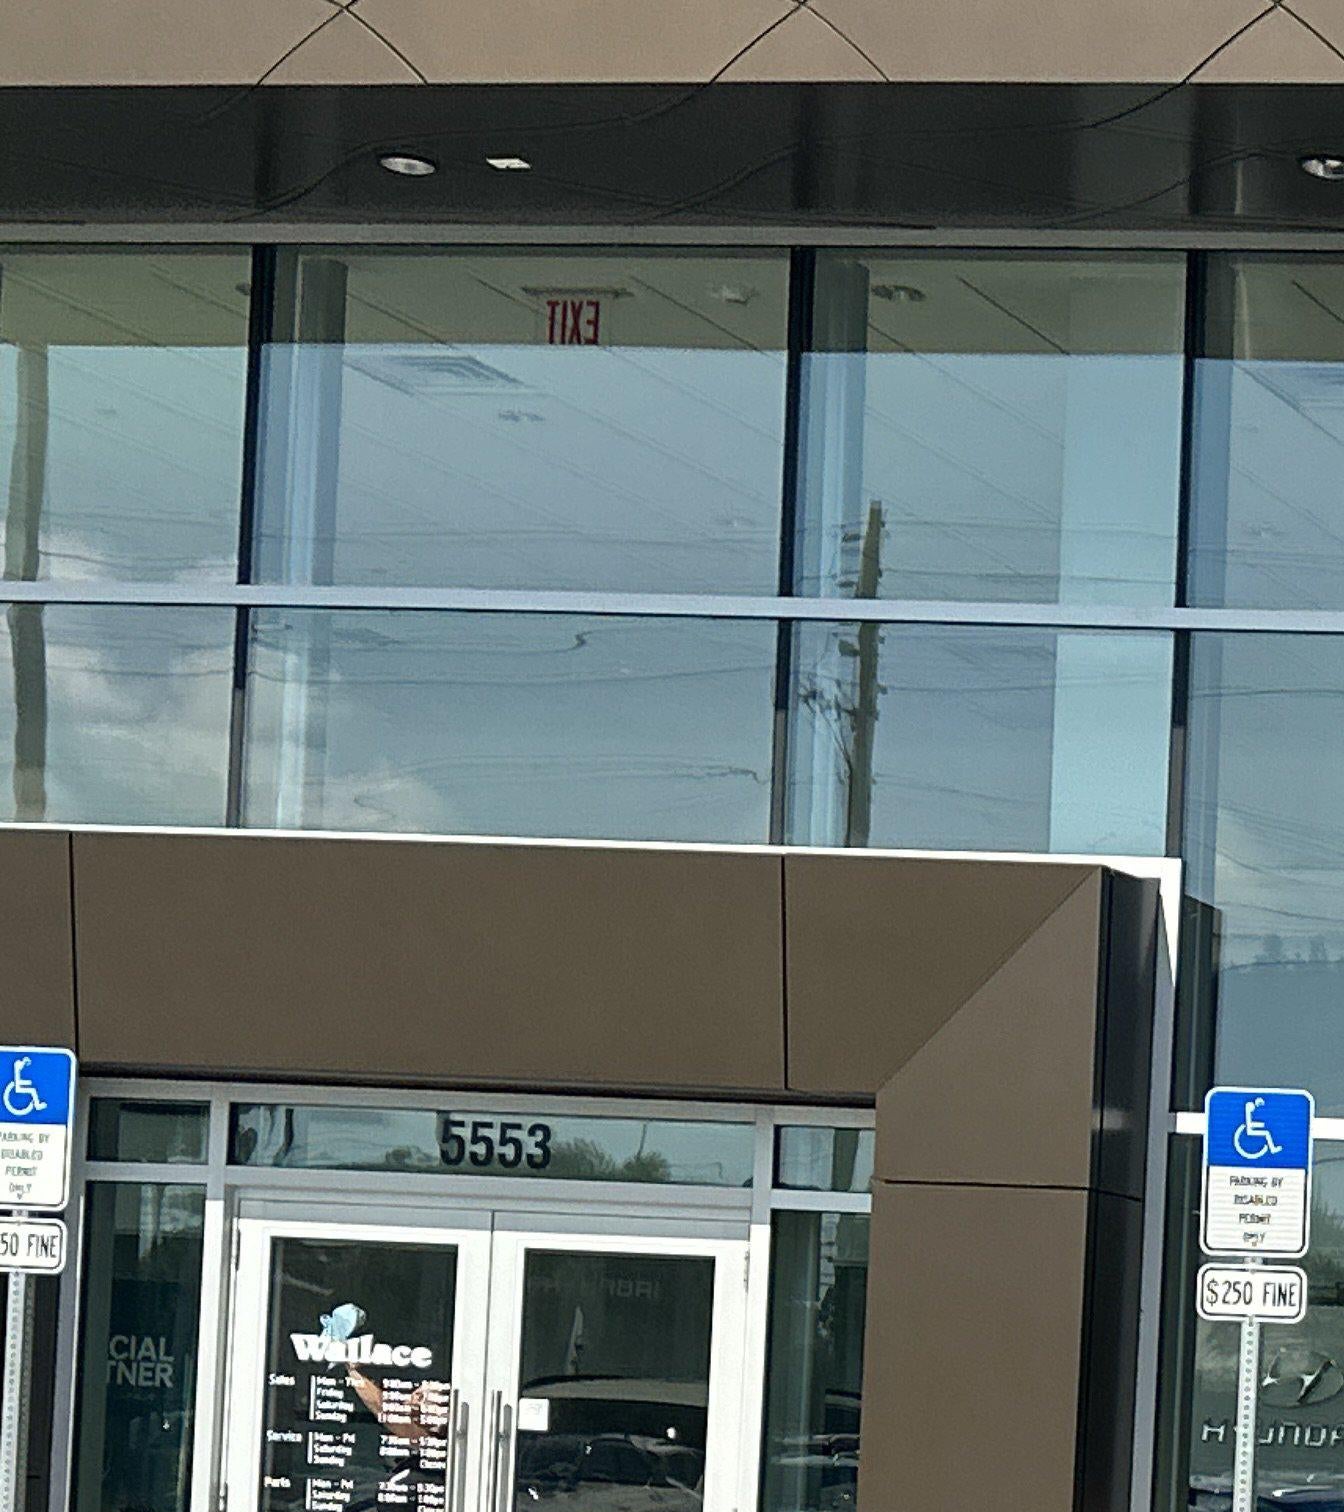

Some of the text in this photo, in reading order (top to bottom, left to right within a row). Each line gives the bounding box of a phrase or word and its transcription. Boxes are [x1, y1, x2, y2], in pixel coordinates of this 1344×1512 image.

[0, 1131, 34, 1144] ARKING
[440, 1120, 552, 1169] 5553
[27, 1233, 58, 1258] FINE
[1206, 1278, 1297, 1307] $250 FINE
[290, 1333, 433, 1368] Wallace
[267, 1430, 302, 1442] Service
[264, 1475, 291, 1488] Parts
